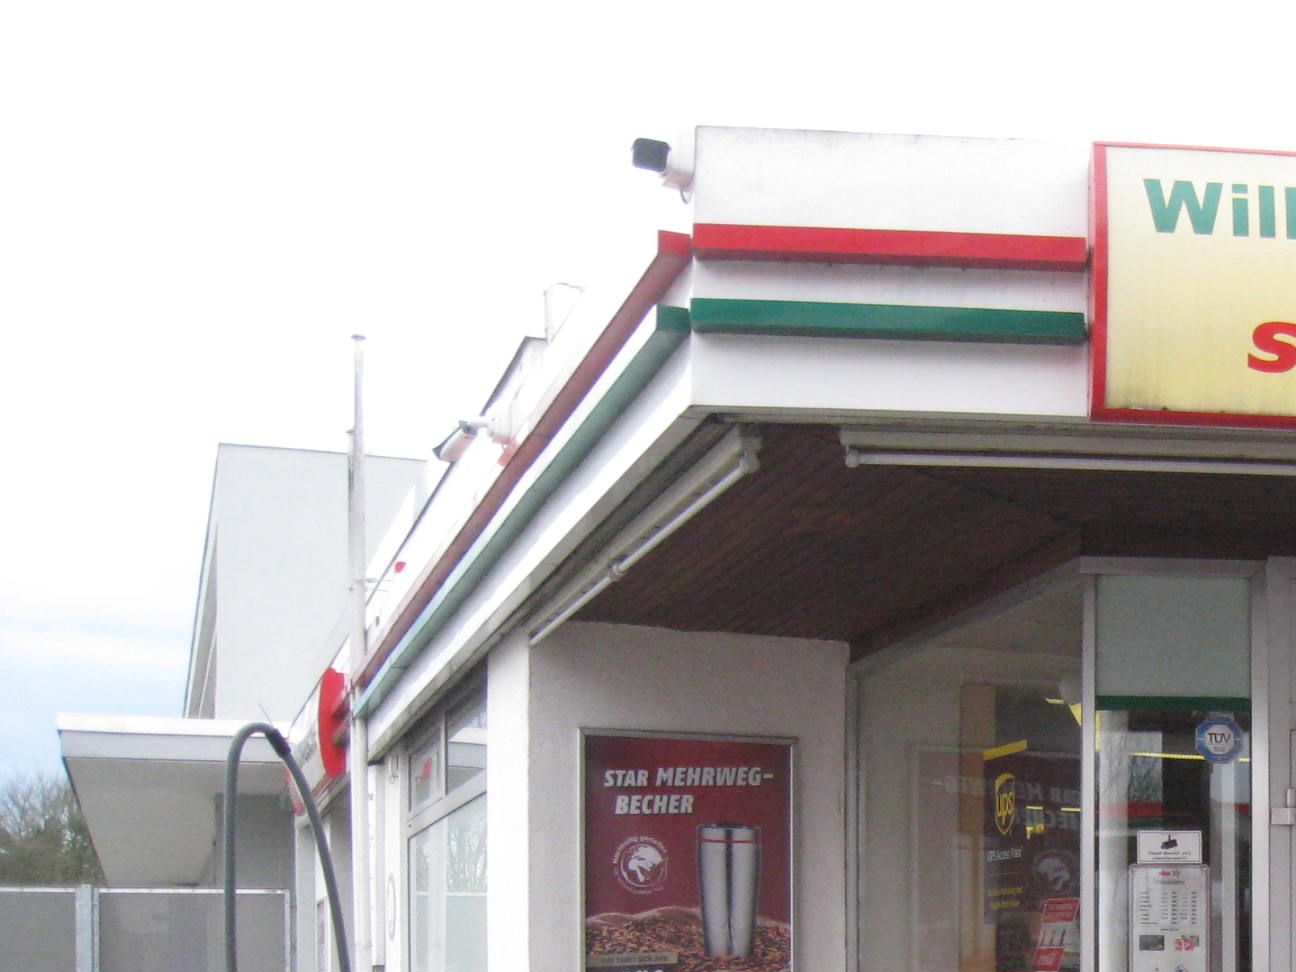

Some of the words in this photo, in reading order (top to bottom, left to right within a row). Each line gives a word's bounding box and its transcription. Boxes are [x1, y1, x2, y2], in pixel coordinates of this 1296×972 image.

[604, 770, 649, 788] STAR
[655, 767, 773, 787] MEHRWEG-
[615, 795, 695, 815] BECHER
